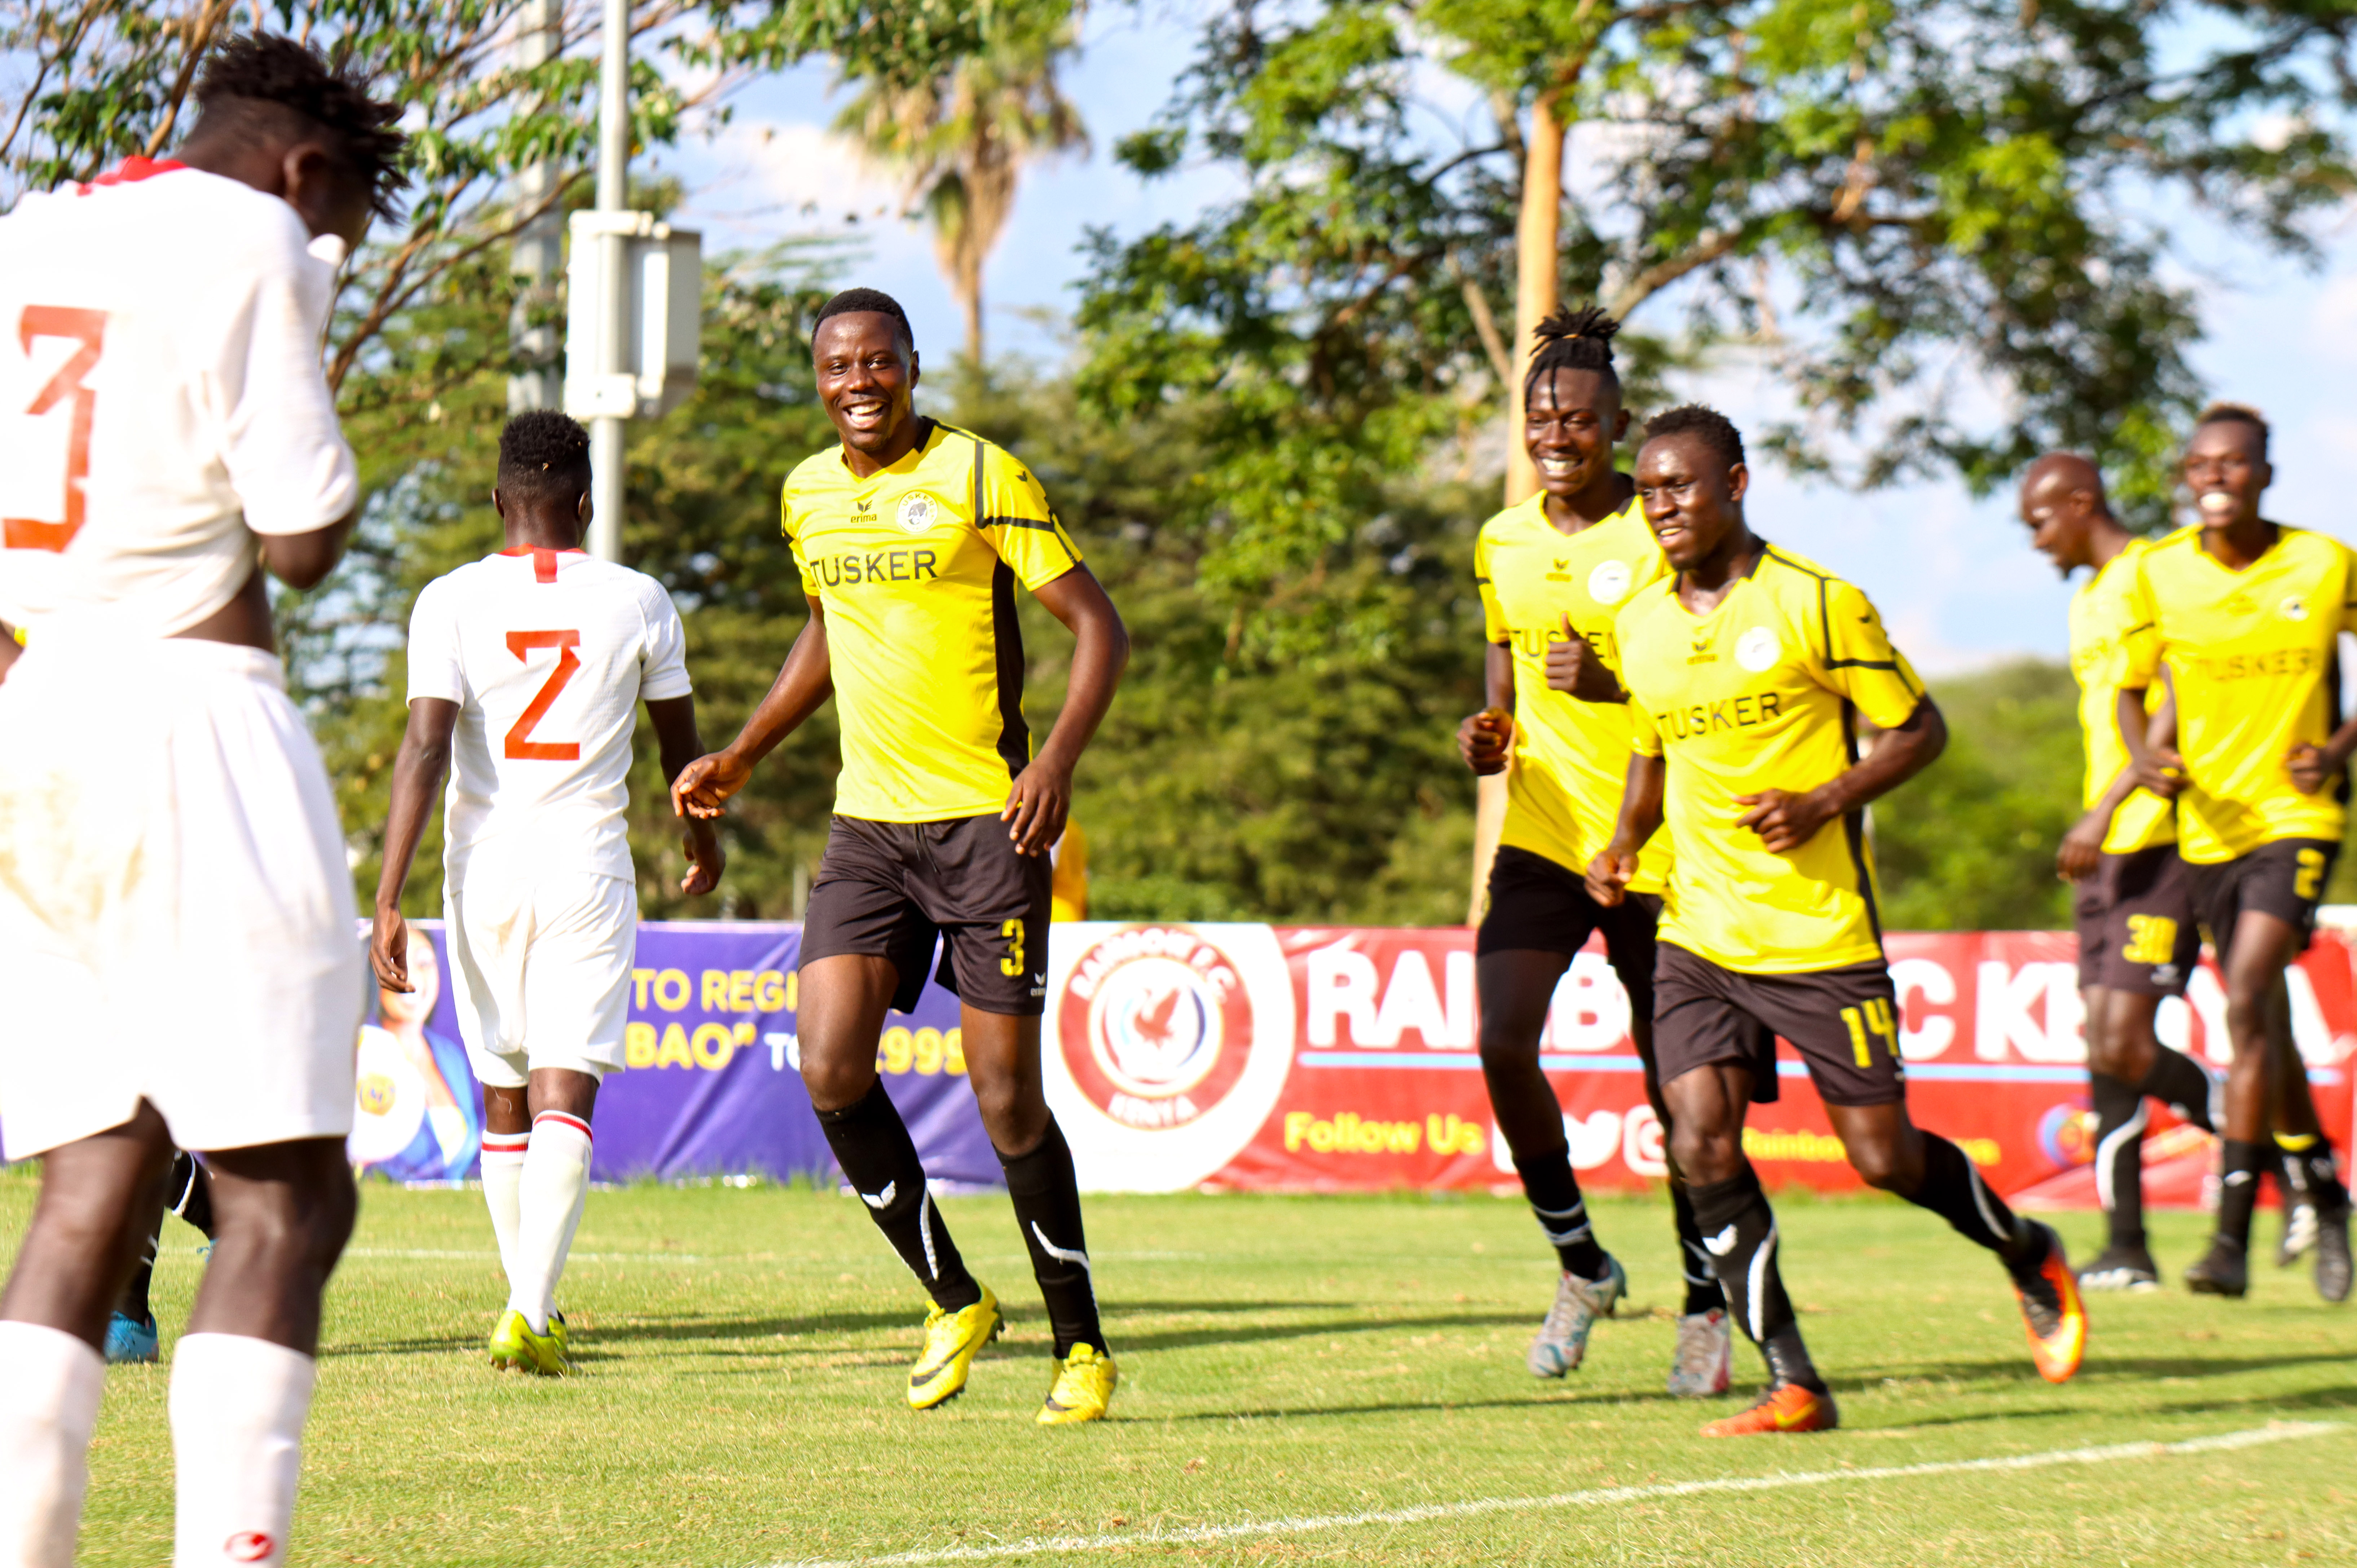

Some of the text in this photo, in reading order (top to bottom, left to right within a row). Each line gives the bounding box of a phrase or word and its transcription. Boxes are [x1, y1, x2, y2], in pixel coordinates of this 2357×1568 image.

[2, 304, 109, 553] 3
[851, 513, 877, 523] erima
[900, 493, 934, 511] USKER
[810, 550, 939, 589] TUSKER
[505, 630, 581, 760] 2
[1657, 692, 1781, 742] TUSKER
[2294, 848, 2326, 900] 2
[1000, 918, 1024, 976] 3
[632, 968, 798, 1013] TO REGI
[1840, 996, 1901, 1069] 14
[1285, 1112, 1486, 1155] Follow Us
